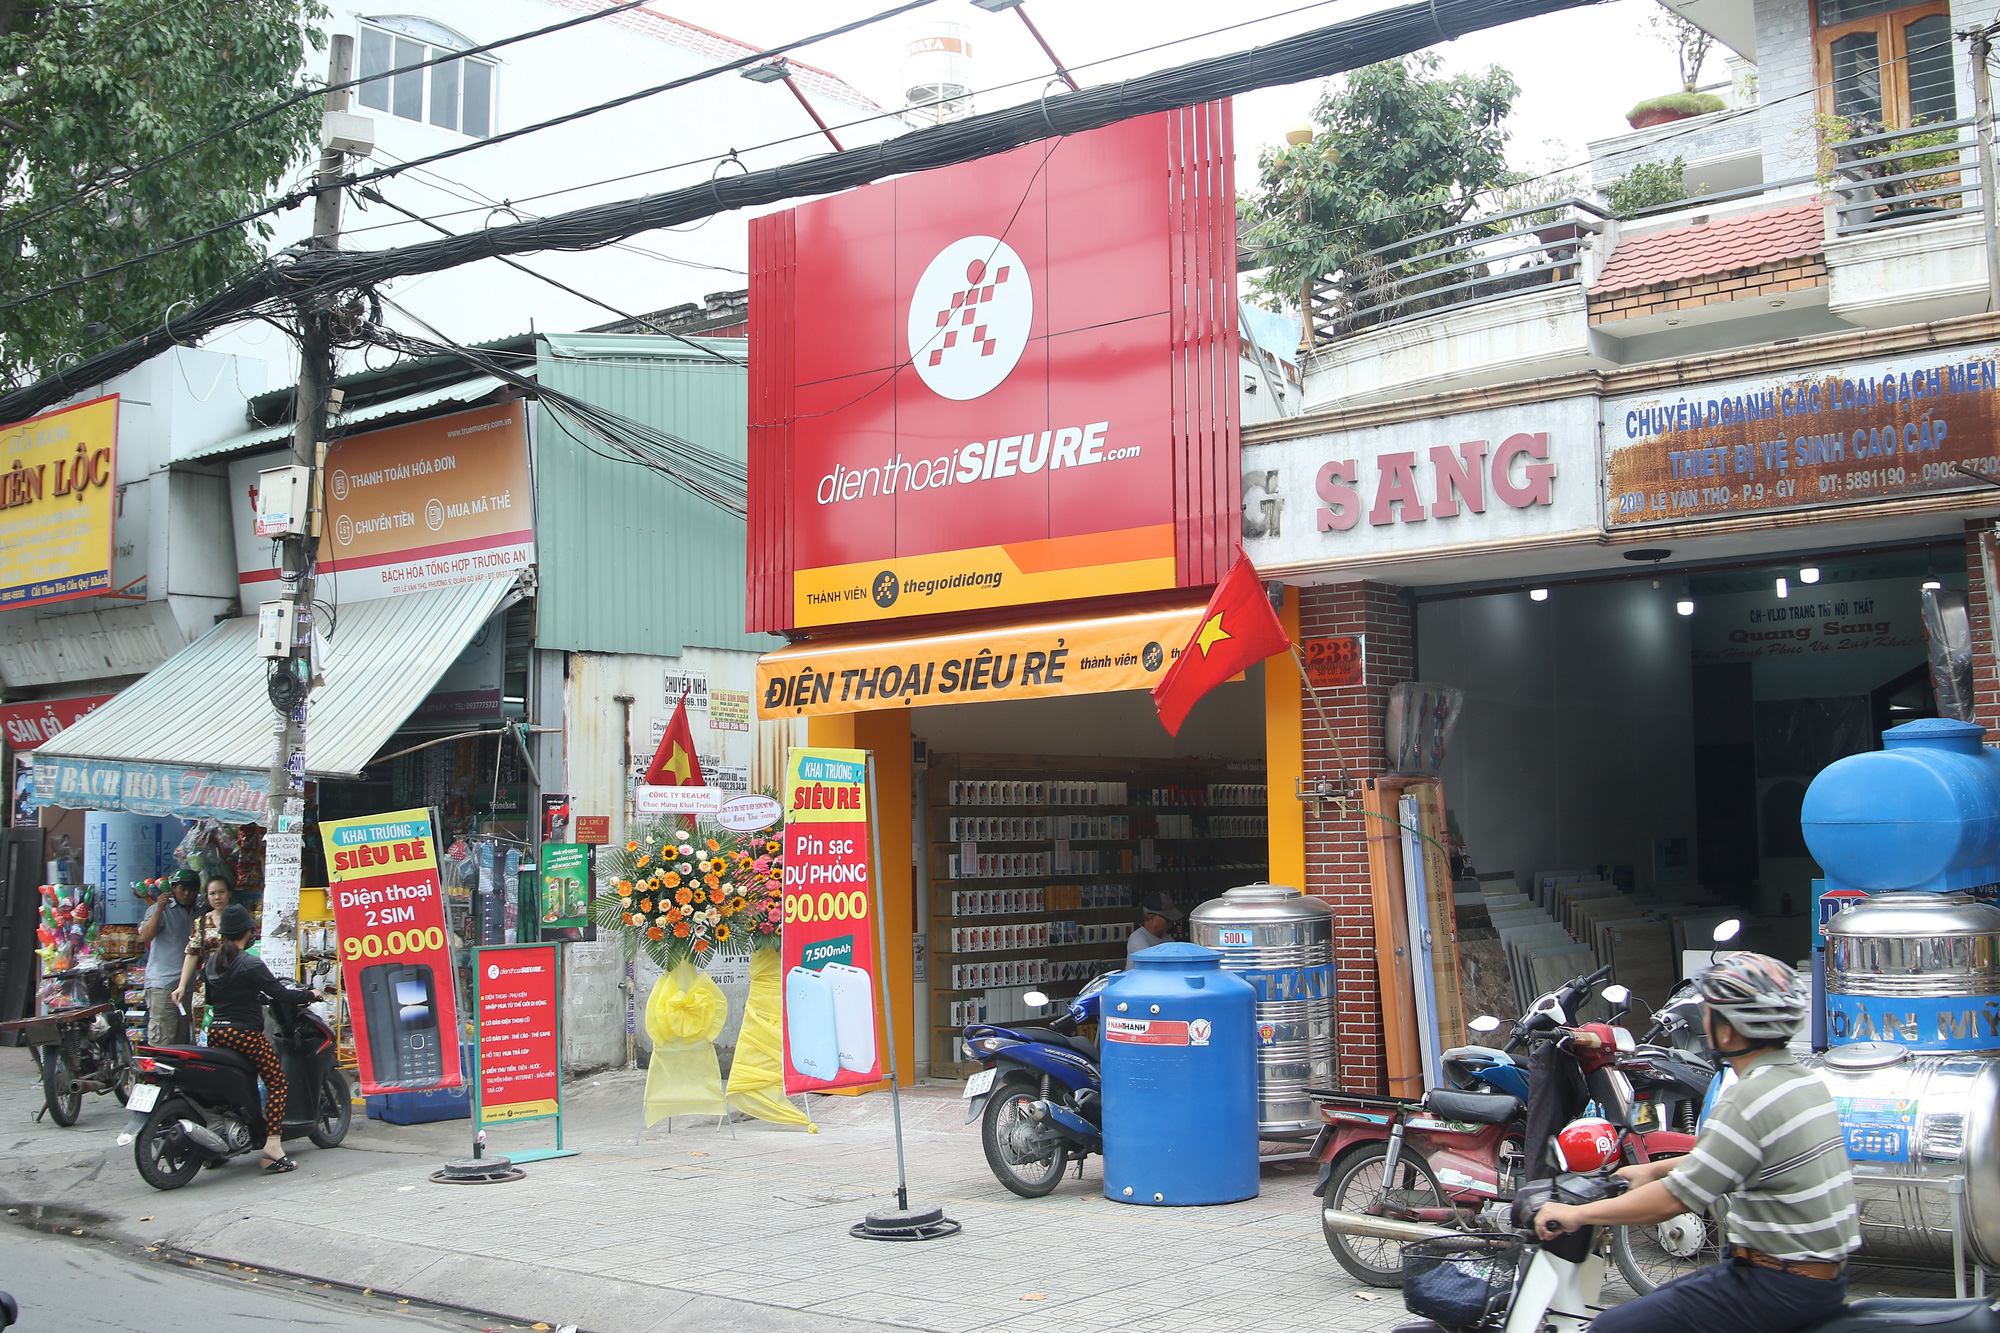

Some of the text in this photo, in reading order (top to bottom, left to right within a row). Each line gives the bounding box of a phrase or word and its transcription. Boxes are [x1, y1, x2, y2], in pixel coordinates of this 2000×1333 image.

[1626, 360, 1997, 439] CHUYÊN DOANH CÁC LOẠI GẠCH MEN
[9, 423, 71, 455] CỬA HÀNG
[446, 417, 512, 438] www.truemoney.com.vn
[1669, 408, 1947, 480] THIẾT BỊ VỆ SINH CAO CẤP
[52, 442, 111, 502] LỘC
[351, 455, 457, 488] THANH TOÁN HÓA ĐƠN
[1315, 431, 1558, 533] SANG
[446, 489, 512, 518] MUA MÃ THẺ
[1619, 466, 1905, 515] 209 LÊ VĂN THỌ P.9 GV ĐT: 5891190
[355, 509, 415, 535] CHUYỂN TIỀN
[381, 549, 526, 583] BÁCH HÓA TỔNG HỢP TRƯỜNG AN
[807, 571, 1003, 605] THÀNH VIÊN thegioididong
[1788, 604, 1816, 620] TRANG
[1853, 596, 1875, 615] THẤT
[1728, 620, 1892, 643] Quang Sang
[1310, 640, 1358, 665] 233
[692, 674, 708, 695] NHÀ
[764, 637, 1138, 715] ĐIỆN THOẠI SIÊU RẺ thành viên
[7, 713, 43, 742] SÀN
[40, 704, 63, 738] GỖ
[60, 761, 172, 800] BÁCH HÓA
[804, 760, 853, 780] KHAI TRƯƠNG
[648, 791, 669, 799] CÔNG
[793, 782, 835, 810] SIÊU
[837, 781, 861, 809] RẺ
[341, 824, 412, 844] KHAI TRƯƠNG
[796, 834, 854, 861] Pin sạc
[334, 836, 427, 871] SIÊU RẺ
[785, 858, 867, 891] DỰ PHÒNG
[340, 879, 432, 910] Điện thoại
[784, 890, 868, 924] 90.000
[364, 905, 415, 927] 2 SIM
[343, 926, 444, 961] 90.000
[805, 943, 852, 962] 7.500mAh
[1849, 1128, 1900, 1156] 500
